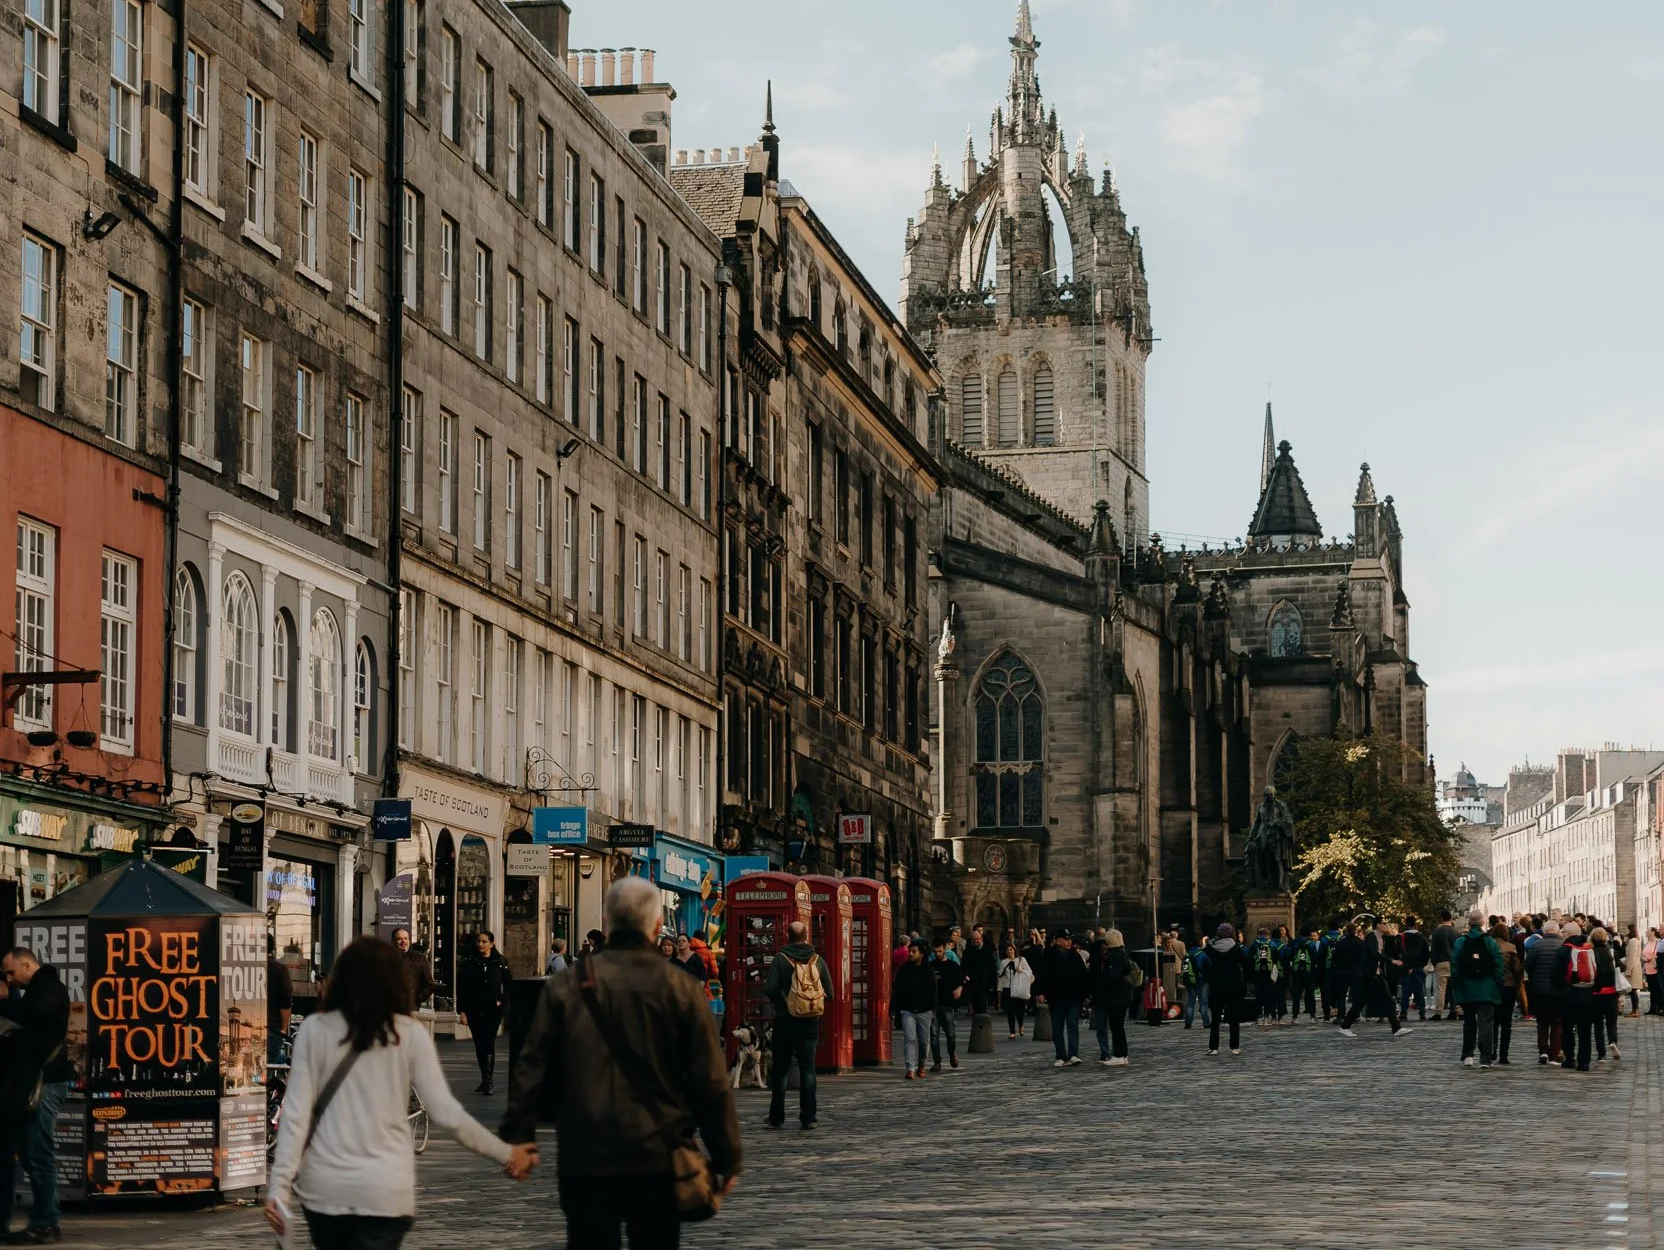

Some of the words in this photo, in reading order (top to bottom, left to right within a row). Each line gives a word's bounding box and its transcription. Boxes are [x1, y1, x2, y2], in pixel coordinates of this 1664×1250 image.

[414, 786, 438, 804] TASTE
[440, 794, 450, 806] OF
[451, 797, 489, 819] SCOTLAND
[271, 811, 284, 829] OF
[289, 816, 324, 838] BENGAL
[547, 830, 560, 838] box
[560, 830, 581, 839] office
[560, 821, 581, 831] fringe
[588, 822, 609, 842] HMERE
[842, 817, 864, 836] B&B
[170, 854, 201, 874] WAY
[737, 891, 786, 900] TELEPHONE
[15, 925, 86, 964] FREE
[105, 927, 200, 975] FREE
[221, 925, 267, 962] FREE
[221, 966, 267, 1001] TOUR
[91, 976, 217, 1020] GHOST
[99, 1023, 213, 1069] TOUR
[124, 1088, 216, 1100] freeghosttour.com
